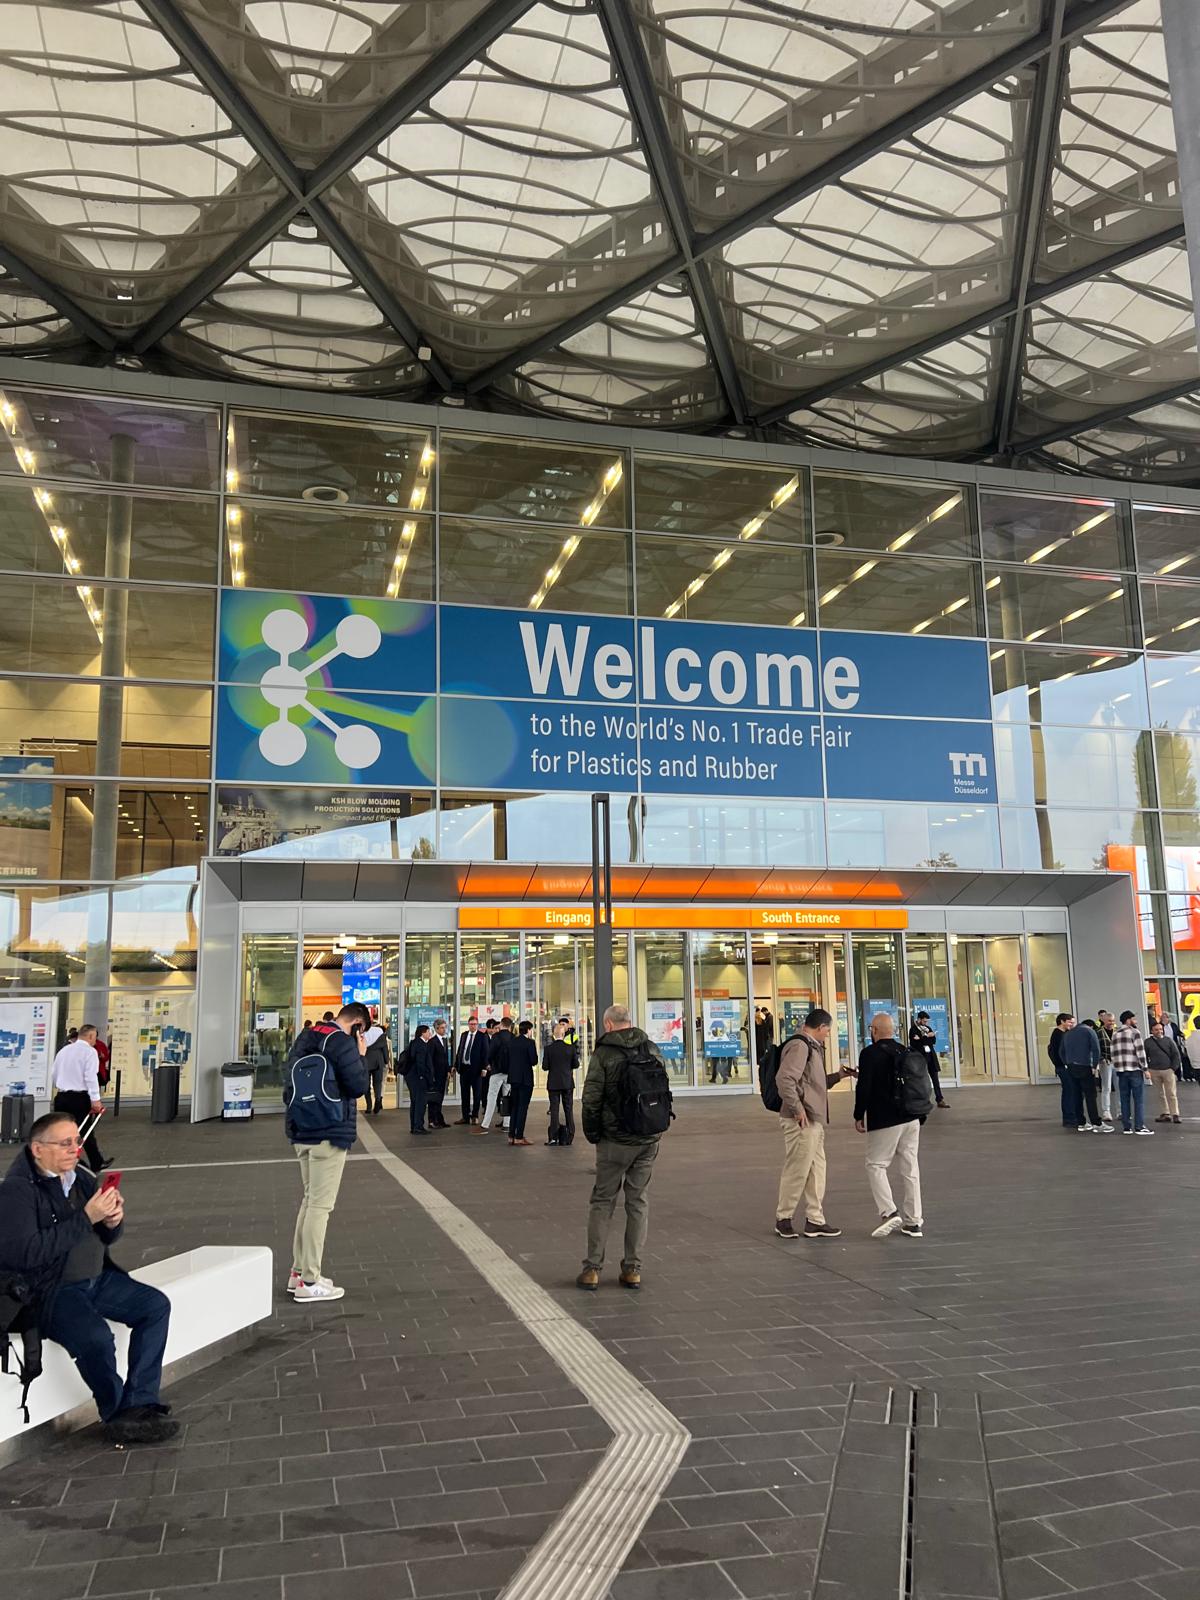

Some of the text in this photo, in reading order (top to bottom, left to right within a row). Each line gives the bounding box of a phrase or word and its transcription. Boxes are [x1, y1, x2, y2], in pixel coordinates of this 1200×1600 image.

[519, 621, 861, 711] Welcome
[530, 713, 553, 736] to
[559, 713, 596, 738] the
[603, 715, 685, 742] World's
[746, 721, 803, 746] Trade
[810, 725, 852, 748] Fair
[530, 749, 778, 781] for Plastics and Rubber
[953, 778, 975, 786] Messe
[954, 786, 989, 795] Düsseldorf
[331, 797, 401, 806] KSH BLOW MOLDING
[314, 805, 401, 814] PRODUCTION SOLUTIONS
[545, 910, 591, 927] Eingang
[761, 911, 841, 924] South Entrance
